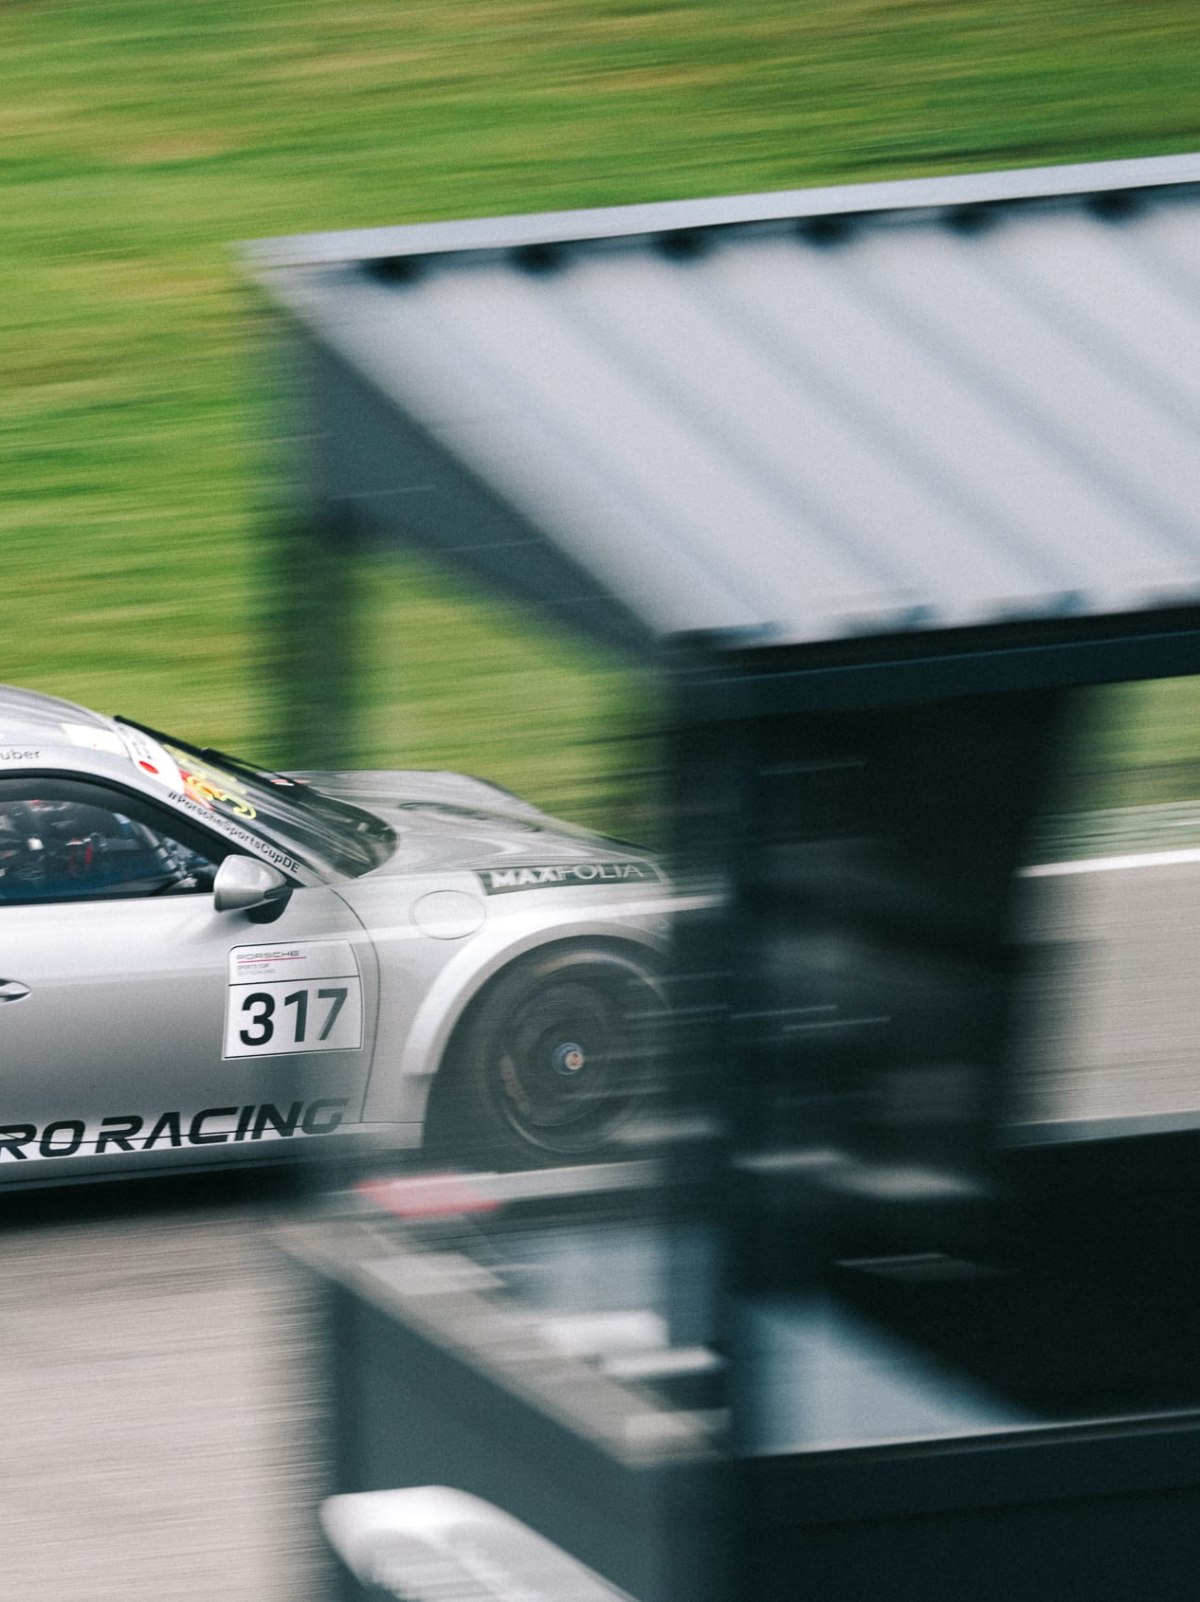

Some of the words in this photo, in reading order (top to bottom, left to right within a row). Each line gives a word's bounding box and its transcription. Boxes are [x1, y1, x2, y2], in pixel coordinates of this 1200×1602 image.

[490, 864, 645, 888] MAXFOLIA
[237, 951, 300, 960] PORSCHE
[240, 987, 348, 1046] 317
[95, 1098, 349, 1154] RACING
